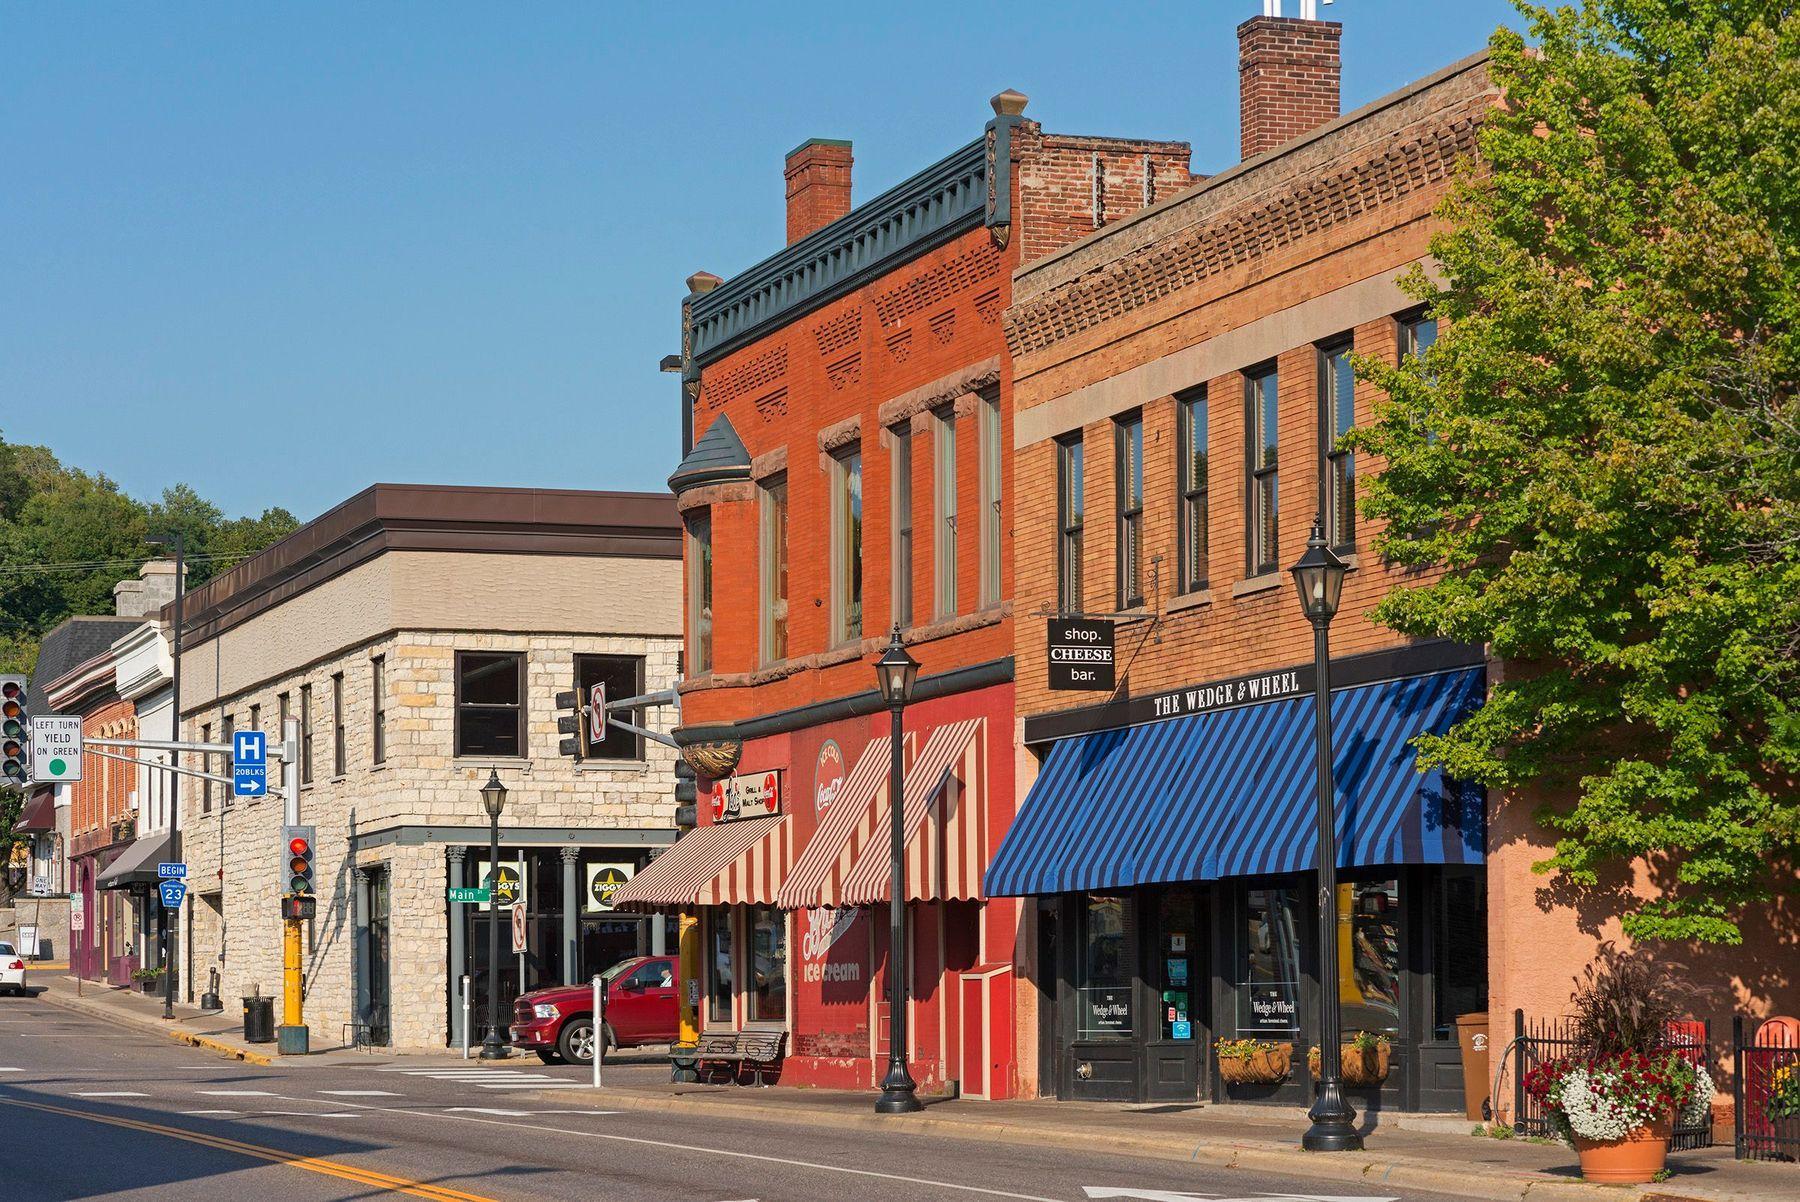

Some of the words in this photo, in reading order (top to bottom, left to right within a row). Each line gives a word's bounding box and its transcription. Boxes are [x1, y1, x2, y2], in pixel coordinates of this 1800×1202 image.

[1065, 627, 1101, 642] shop.
[1051, 648, 1112, 661] CHEESE
[1071, 668, 1096, 681] bar.
[1154, 694, 1180, 717] THE
[1185, 683, 1233, 711] WEDGE
[1237, 681, 1246, 701] &
[1248, 671, 1299, 699] WHEEL
[35, 721, 54, 729] LEFT
[59, 721, 79, 729] TURN
[44, 733, 71, 743] YIELD
[37, 747, 48, 756] ON
[53, 747, 79, 756] GREEN
[240, 736, 260, 760] H
[161, 866, 185, 875] BEGIN
[165, 889, 182, 900] 23
[449, 889, 474, 900] Main
[1092, 1004, 1108, 1019] Wedge
[1112, 1003, 1128, 1016] Wheel
[1253, 1001, 1271, 1017] Wedge
[1277, 1001, 1295, 1013] Wheel
